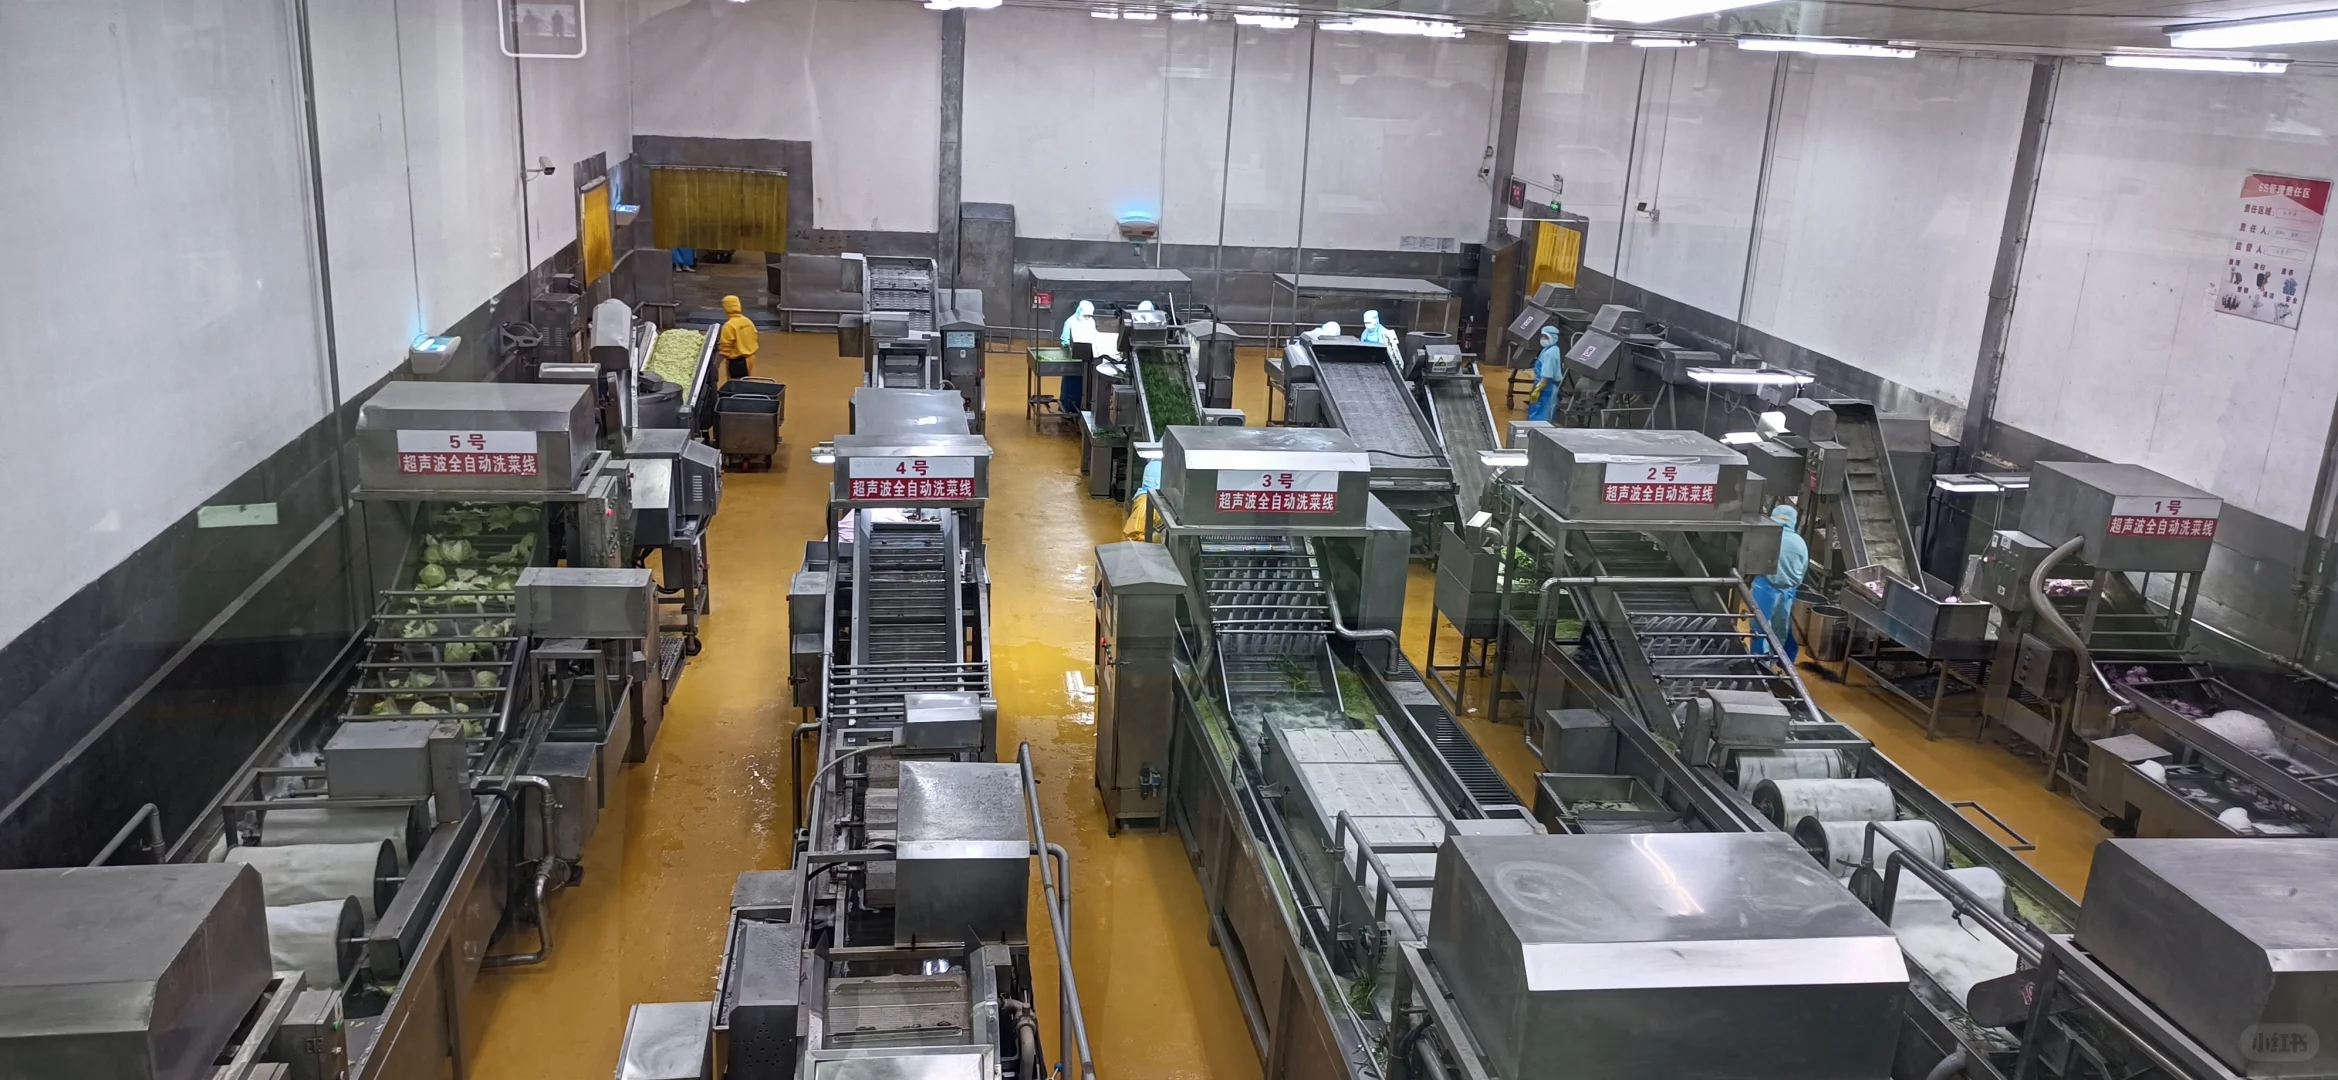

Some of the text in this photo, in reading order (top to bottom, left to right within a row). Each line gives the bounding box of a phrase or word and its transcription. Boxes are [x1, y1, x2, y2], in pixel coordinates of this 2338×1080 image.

[402, 454, 537, 473] 超声波全自动洗菜线
[852, 479, 972, 497] 超声波全自动洗菜线
[1605, 484, 1713, 502] 超声波全自动洗菜线
[1218, 491, 1334, 511] 超声波全自动洗菜线
[2109, 517, 2214, 536] 超声波全自动洗菜线
